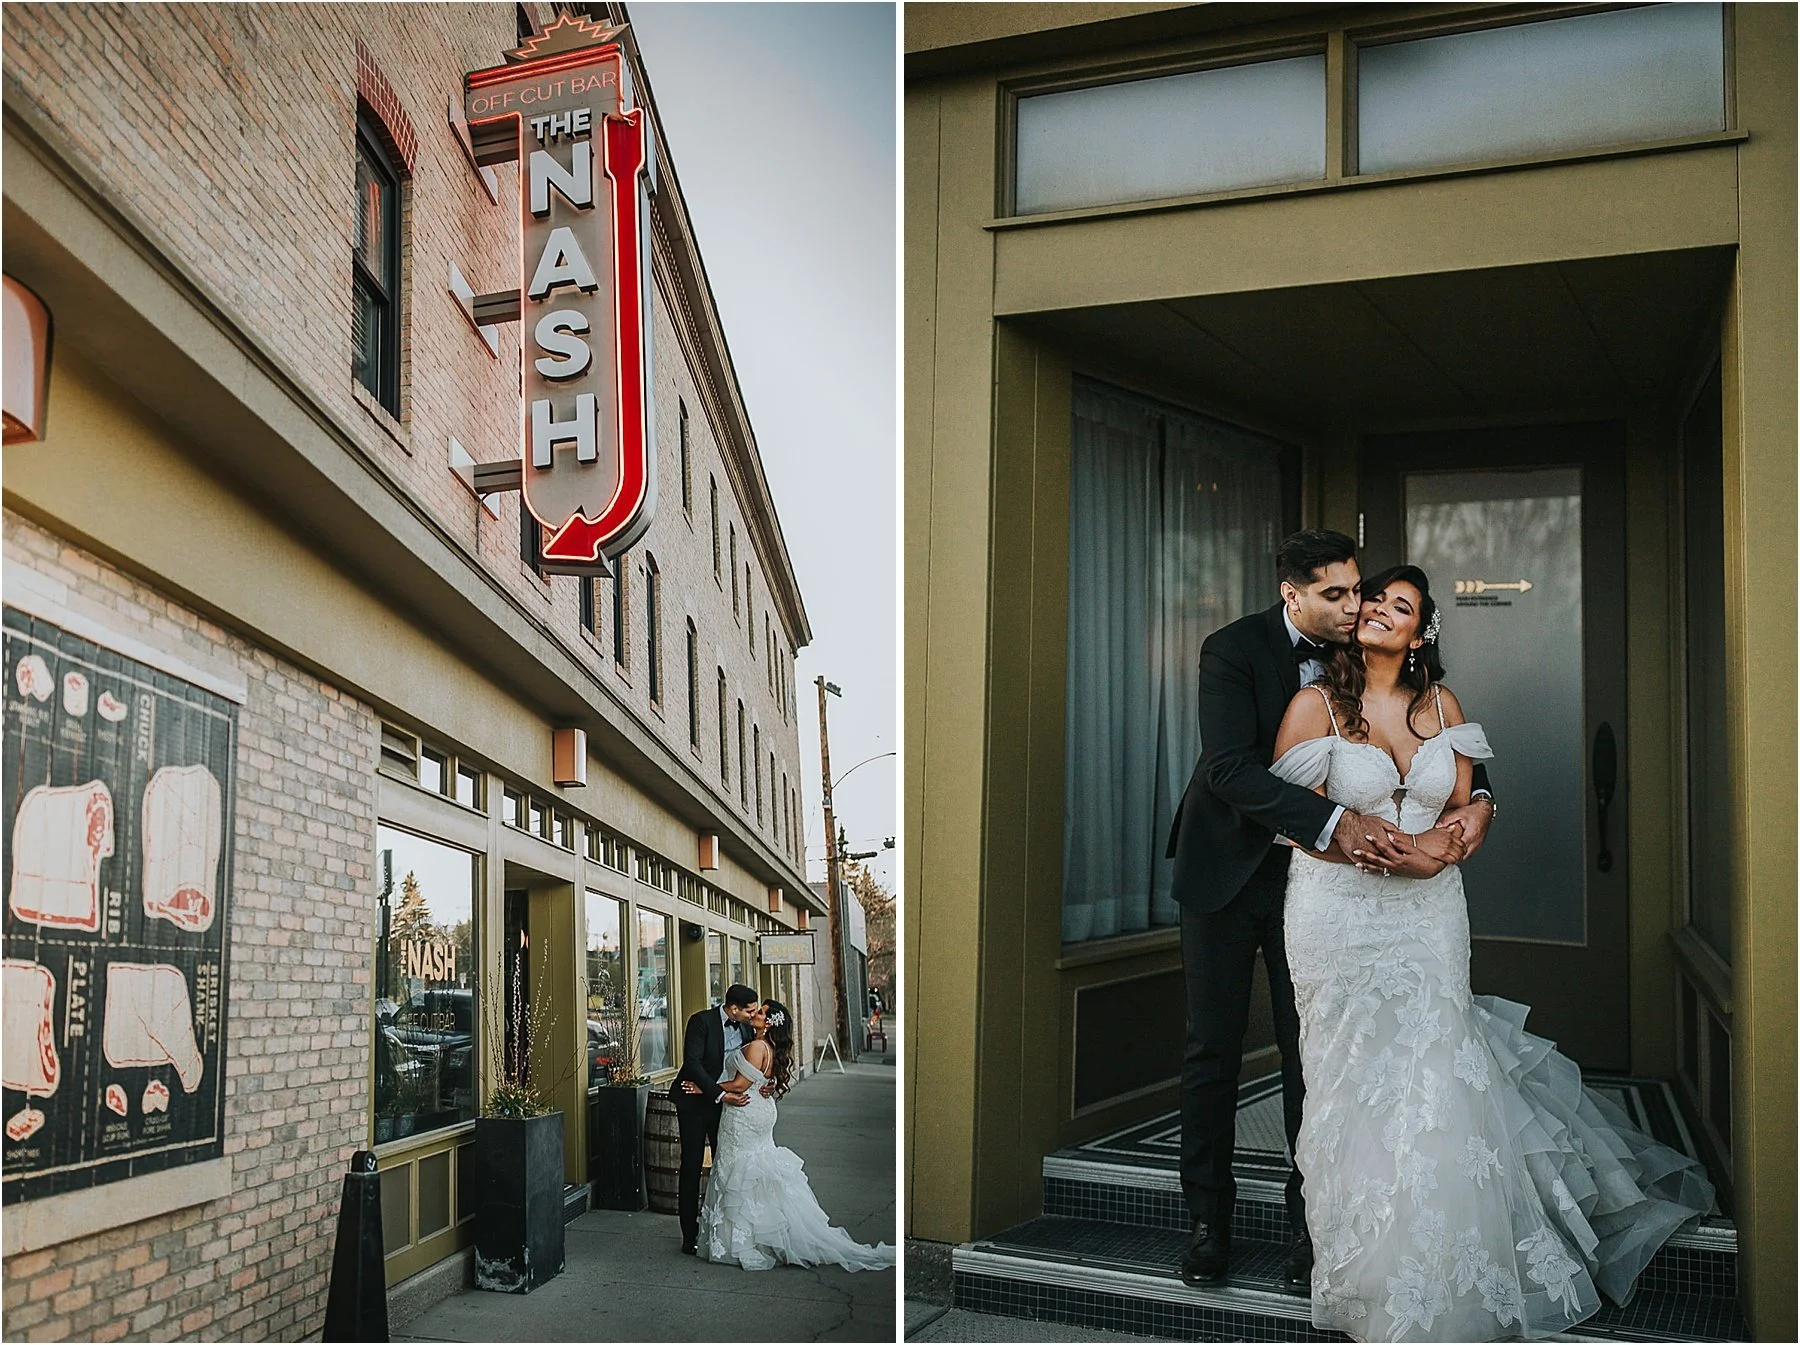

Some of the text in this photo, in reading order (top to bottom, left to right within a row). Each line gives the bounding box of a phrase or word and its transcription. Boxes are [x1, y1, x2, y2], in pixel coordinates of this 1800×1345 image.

[472, 71, 617, 114] OFF CUT BAR
[530, 107, 591, 142] THE
[528, 141, 599, 468] NASH
[136, 694, 150, 762] CHUCK
[107, 891, 122, 934] RIB
[407, 939, 456, 982] NASH
[69, 961, 88, 1037] PLATE
[195, 964, 207, 1026] SHANK
[207, 964, 219, 1043] BRISKET
[420, 1012, 438, 1032] CUT
[439, 1012, 456, 1032] BAR
